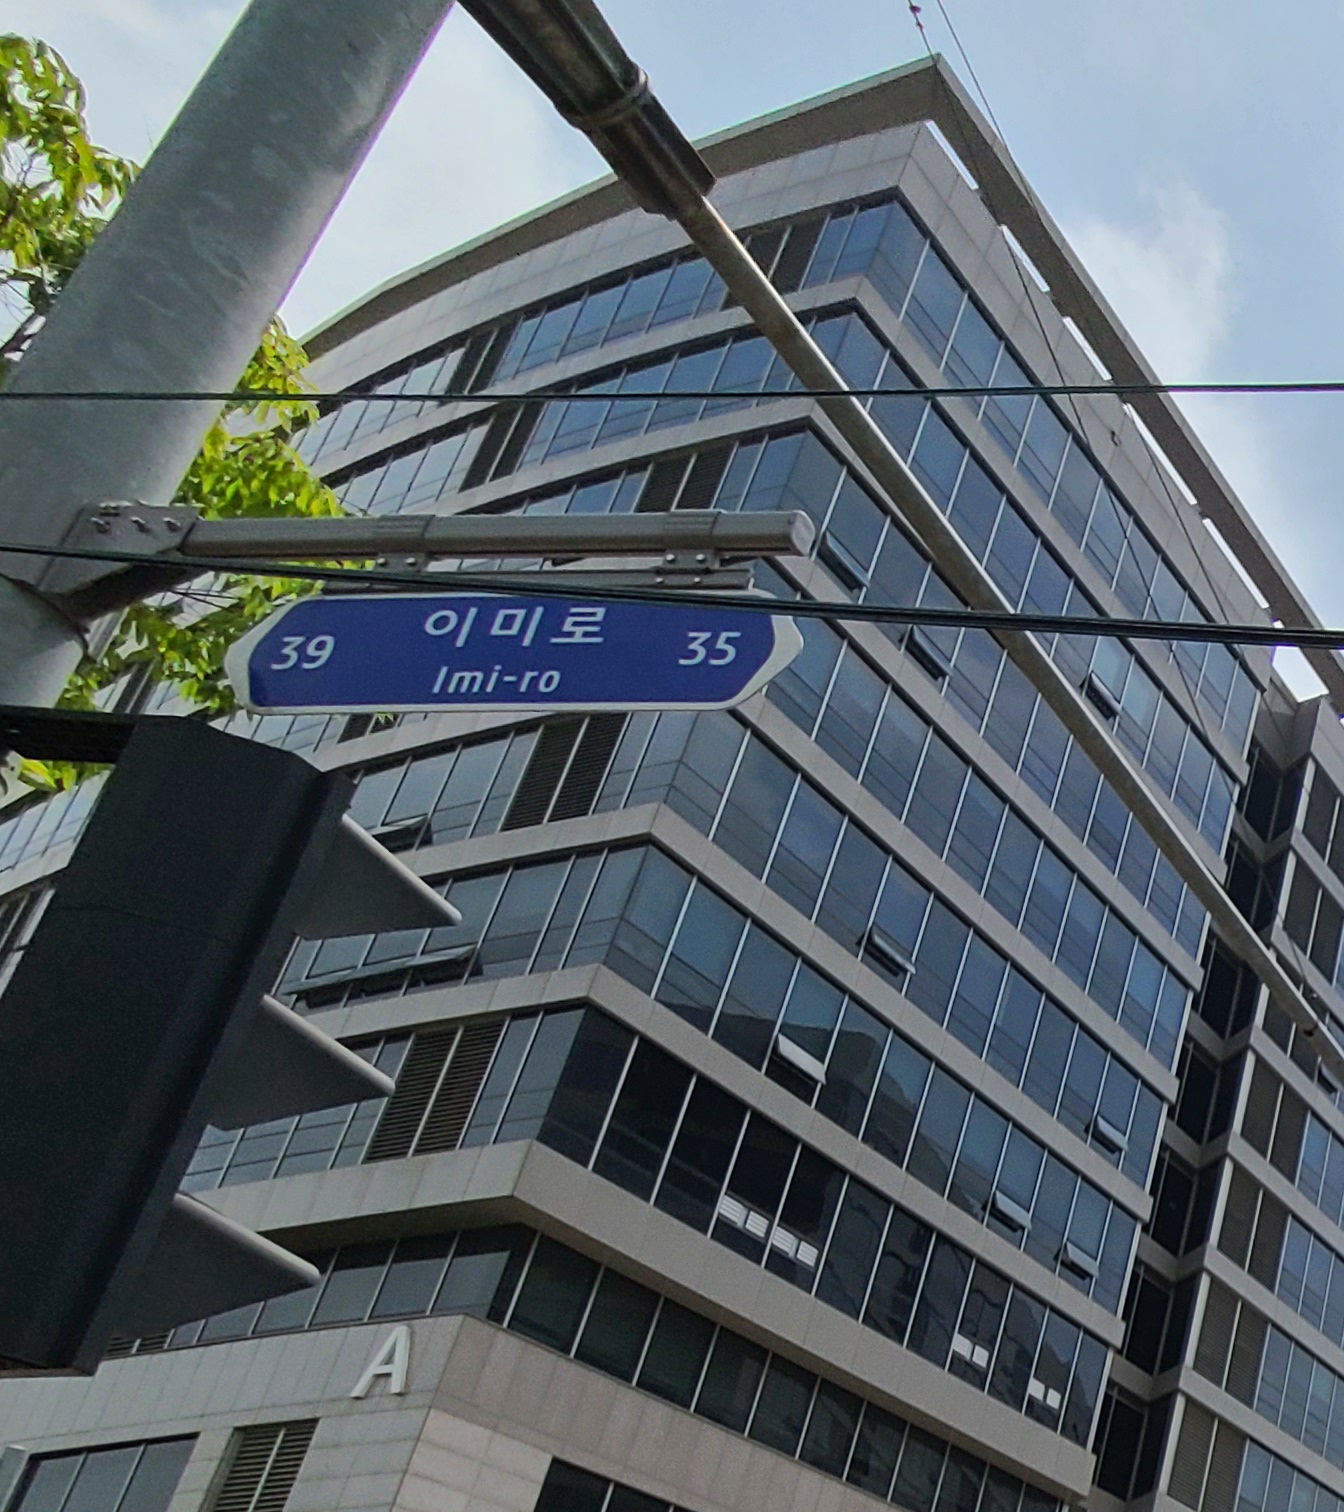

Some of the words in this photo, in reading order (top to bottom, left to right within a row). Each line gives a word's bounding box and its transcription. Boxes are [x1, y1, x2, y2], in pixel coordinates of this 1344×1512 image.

[271, 635, 335, 670] 39
[424, 606, 607, 647] 이미로
[678, 632, 740, 667] 35
[432, 665, 561, 694] Imi-ro
[350, 1325, 411, 1398] A
